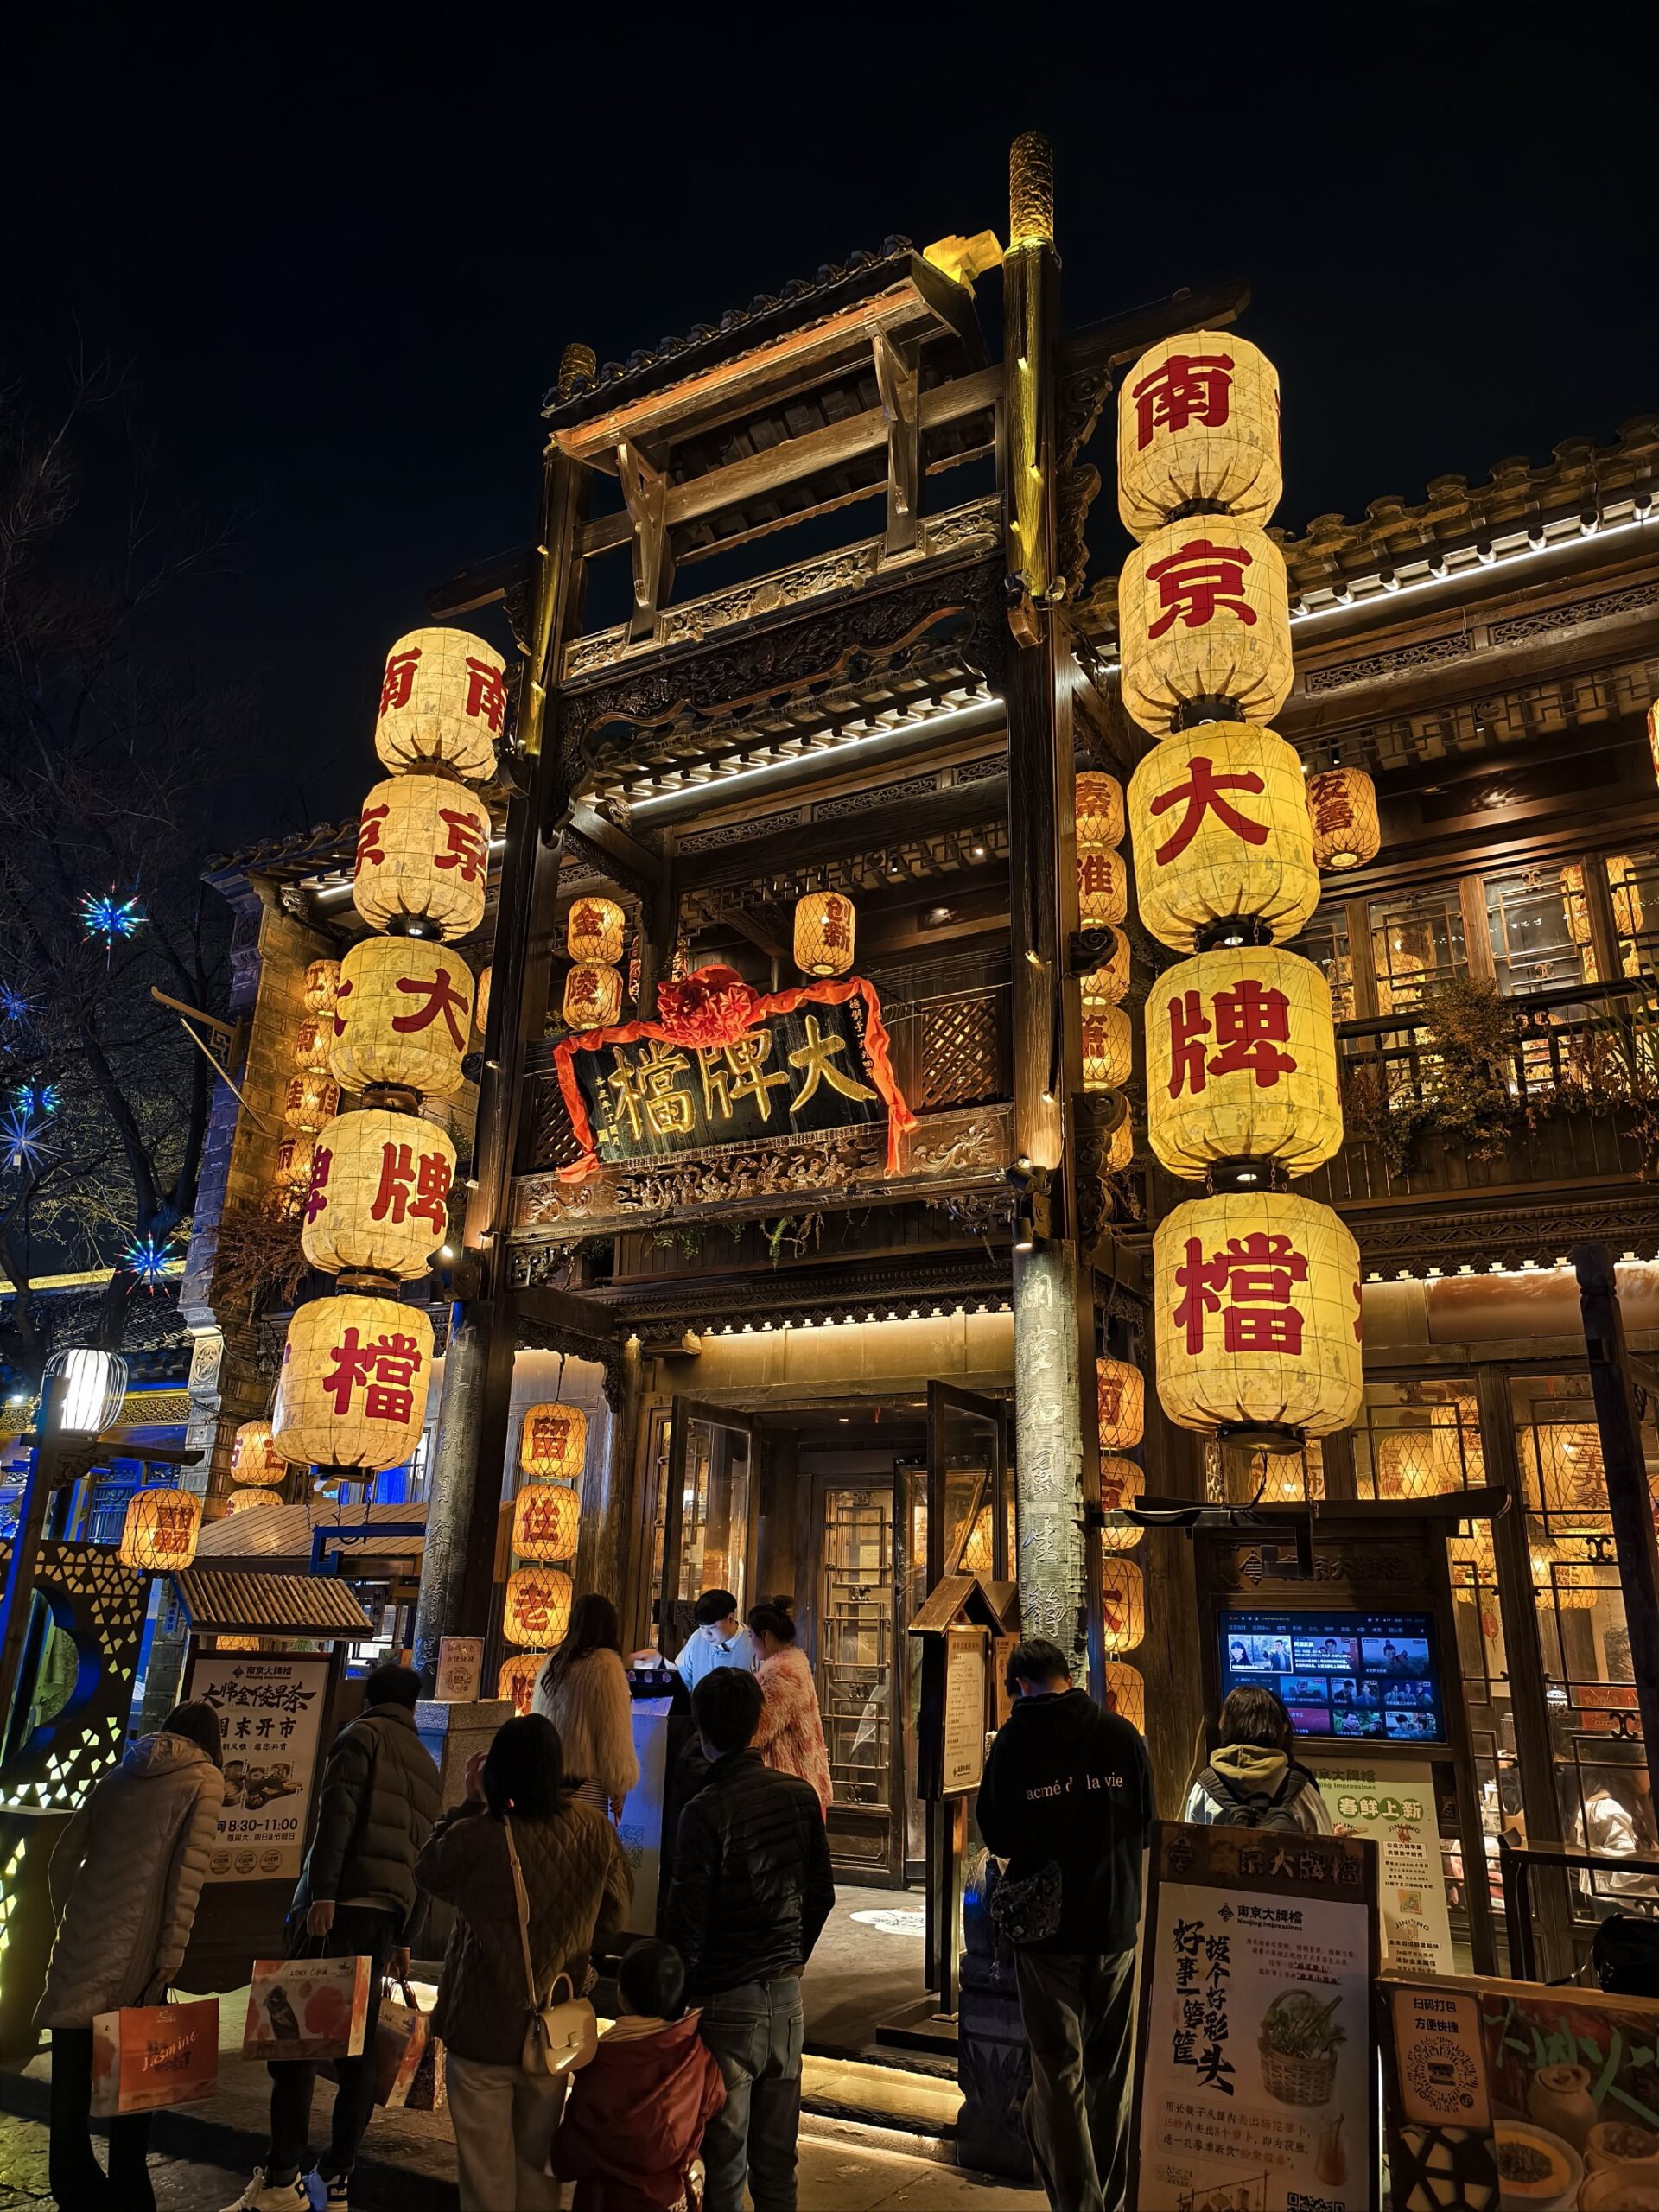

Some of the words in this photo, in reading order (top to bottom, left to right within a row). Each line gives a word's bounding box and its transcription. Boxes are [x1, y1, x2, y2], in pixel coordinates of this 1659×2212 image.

[1132, 353, 1236, 452] 南
[1145, 539, 1258, 640] 京
[1150, 756, 1273, 866] 大
[392, 968, 470, 1052] 大
[1168, 979, 1297, 1099] 牌
[1027, 1779, 1061, 1801] acmé
[1086, 1774, 1101, 1789] la
[1104, 1771, 1123, 1788] vie
[1339, 1798, 1422, 1819] 春鲜上新
[1237, 1919, 1262, 1928] Nanjing
[1414, 1997, 1457, 2012] 扫码打包
[1415, 2018, 1459, 2033] 方便快捷
